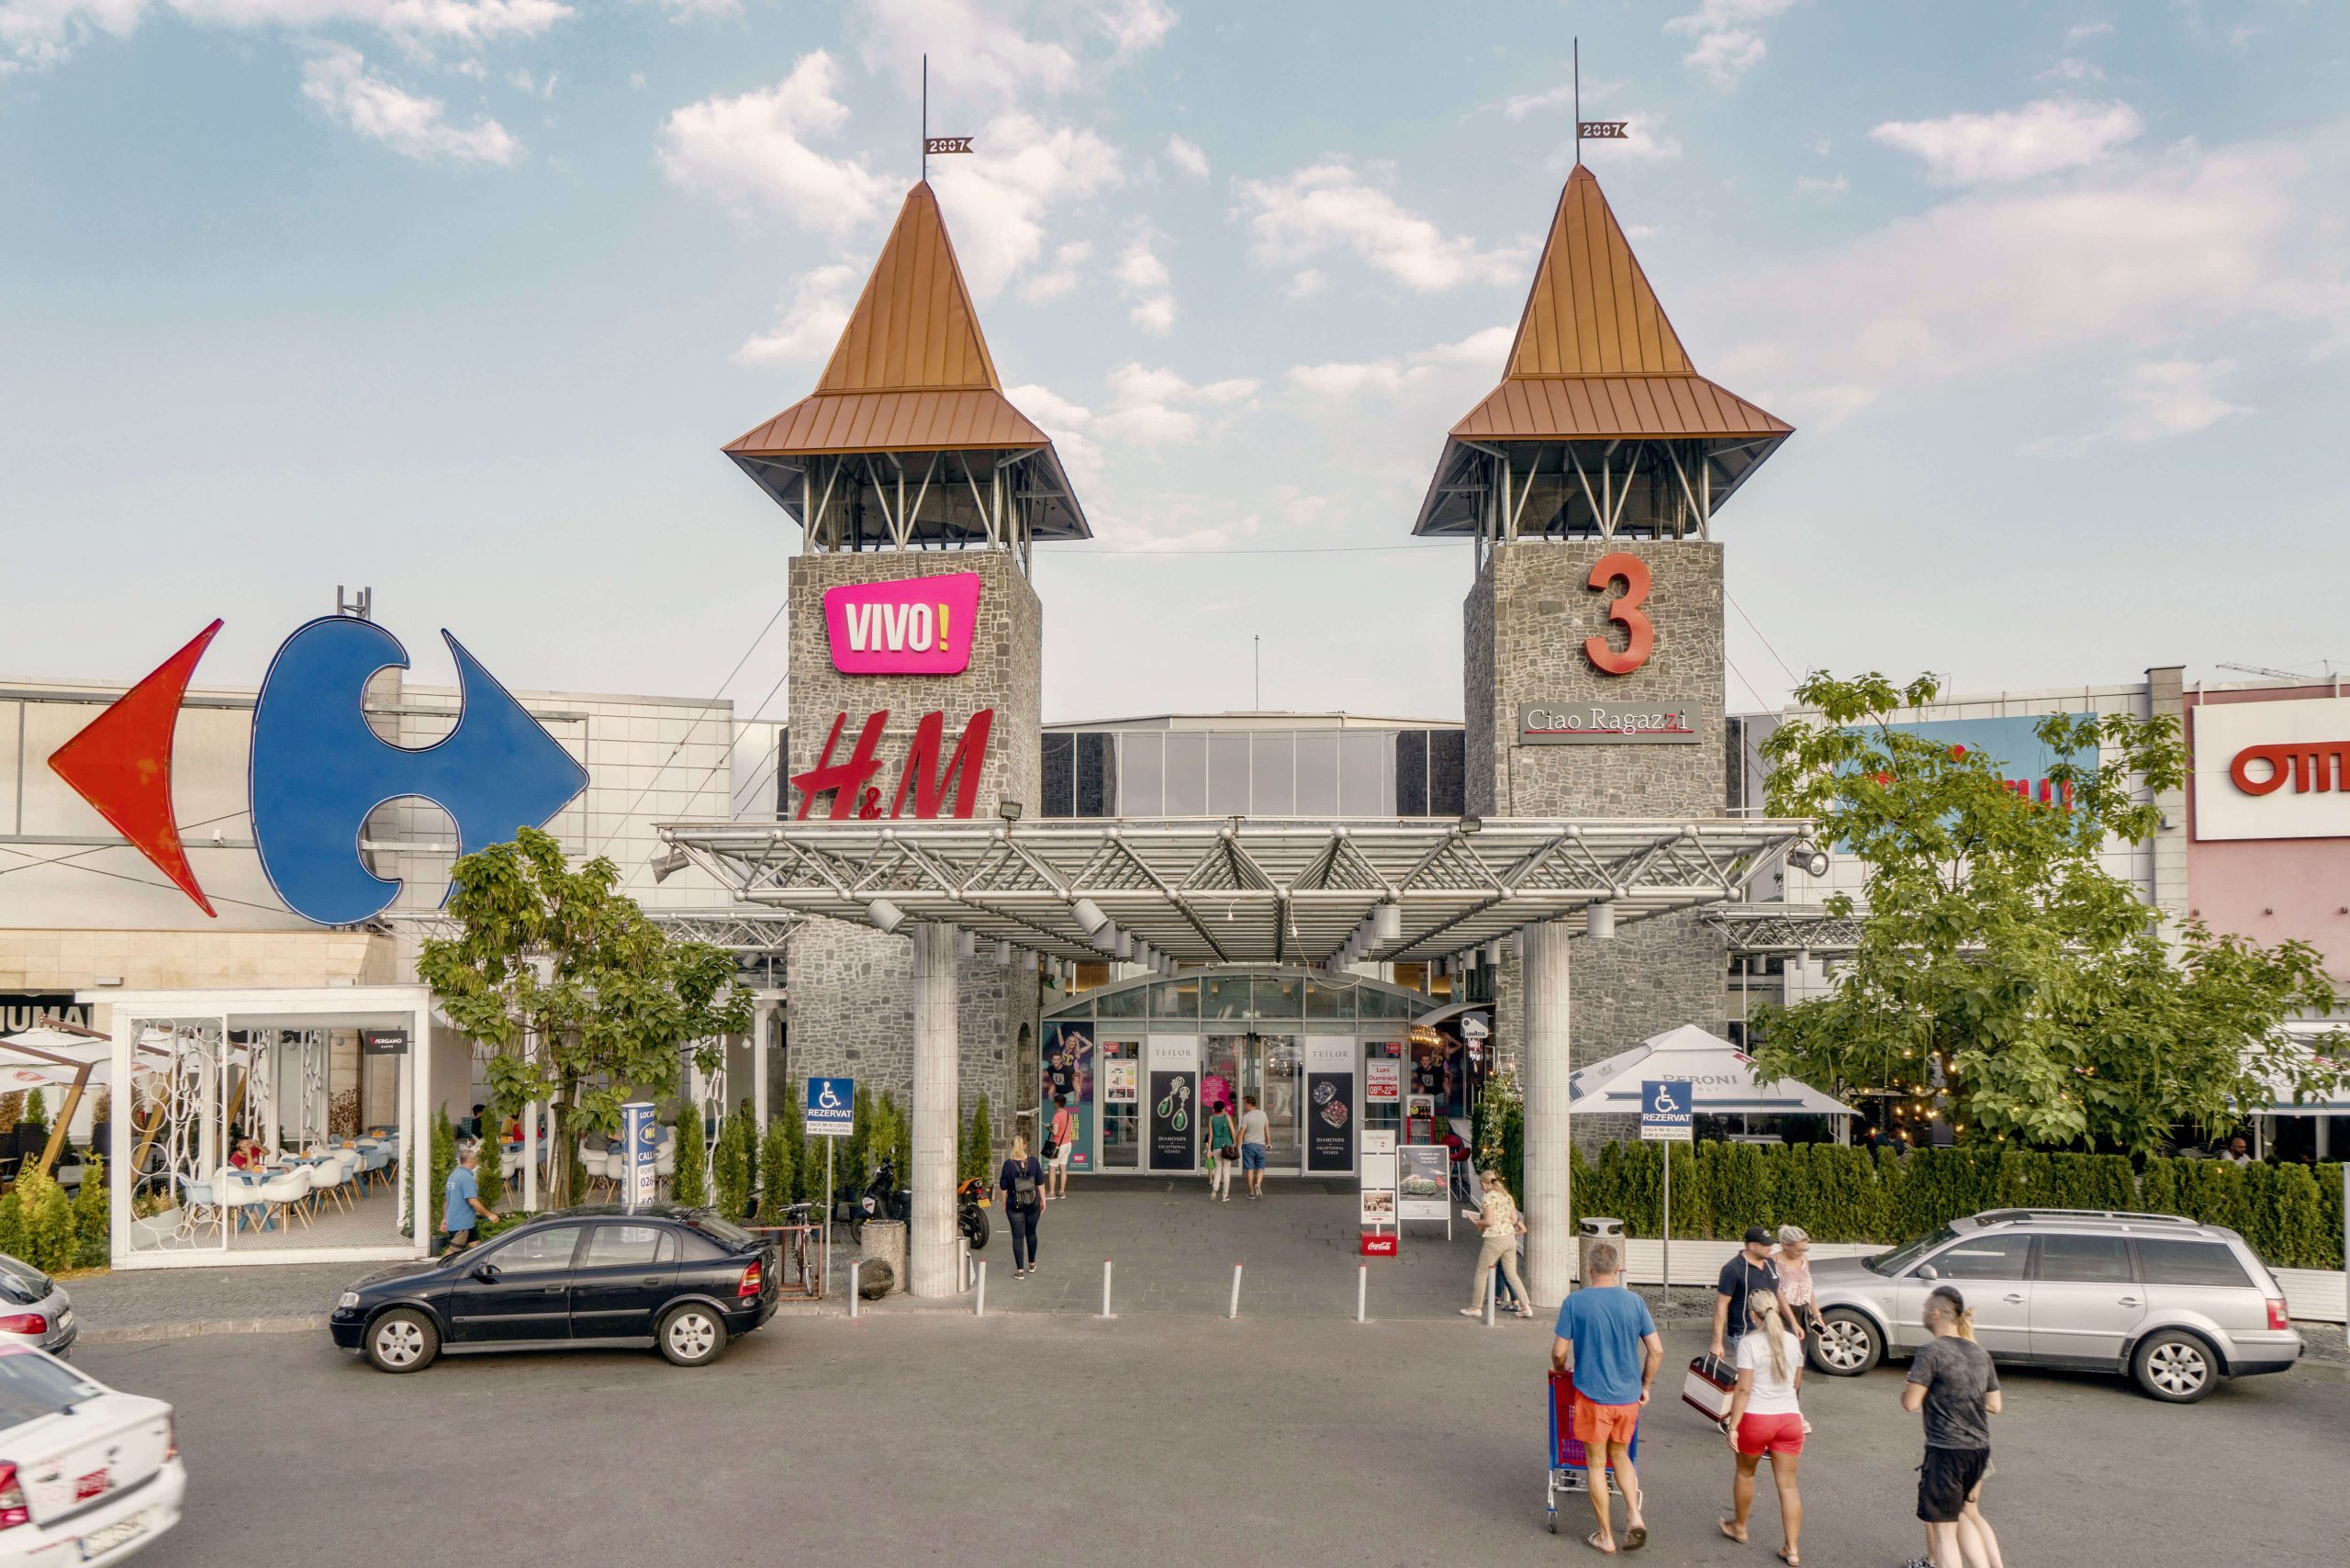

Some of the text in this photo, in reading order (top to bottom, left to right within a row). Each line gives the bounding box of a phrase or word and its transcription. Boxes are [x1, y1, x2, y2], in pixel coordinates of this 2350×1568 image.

[1583, 124, 1620, 137] 2007
[929, 140, 966, 152] 2007
[1583, 553, 1653, 674] 3
[845, 603, 950, 653] VIVO!
[1528, 709, 1688, 735] Ciao Ragazzi
[789, 708, 993, 821] H&M
[808, 1108, 852, 1117] REZERVAT
[1643, 1114, 1691, 1122] REZERVAT
[1367, 1241, 1392, 1250] Coca-Cola
